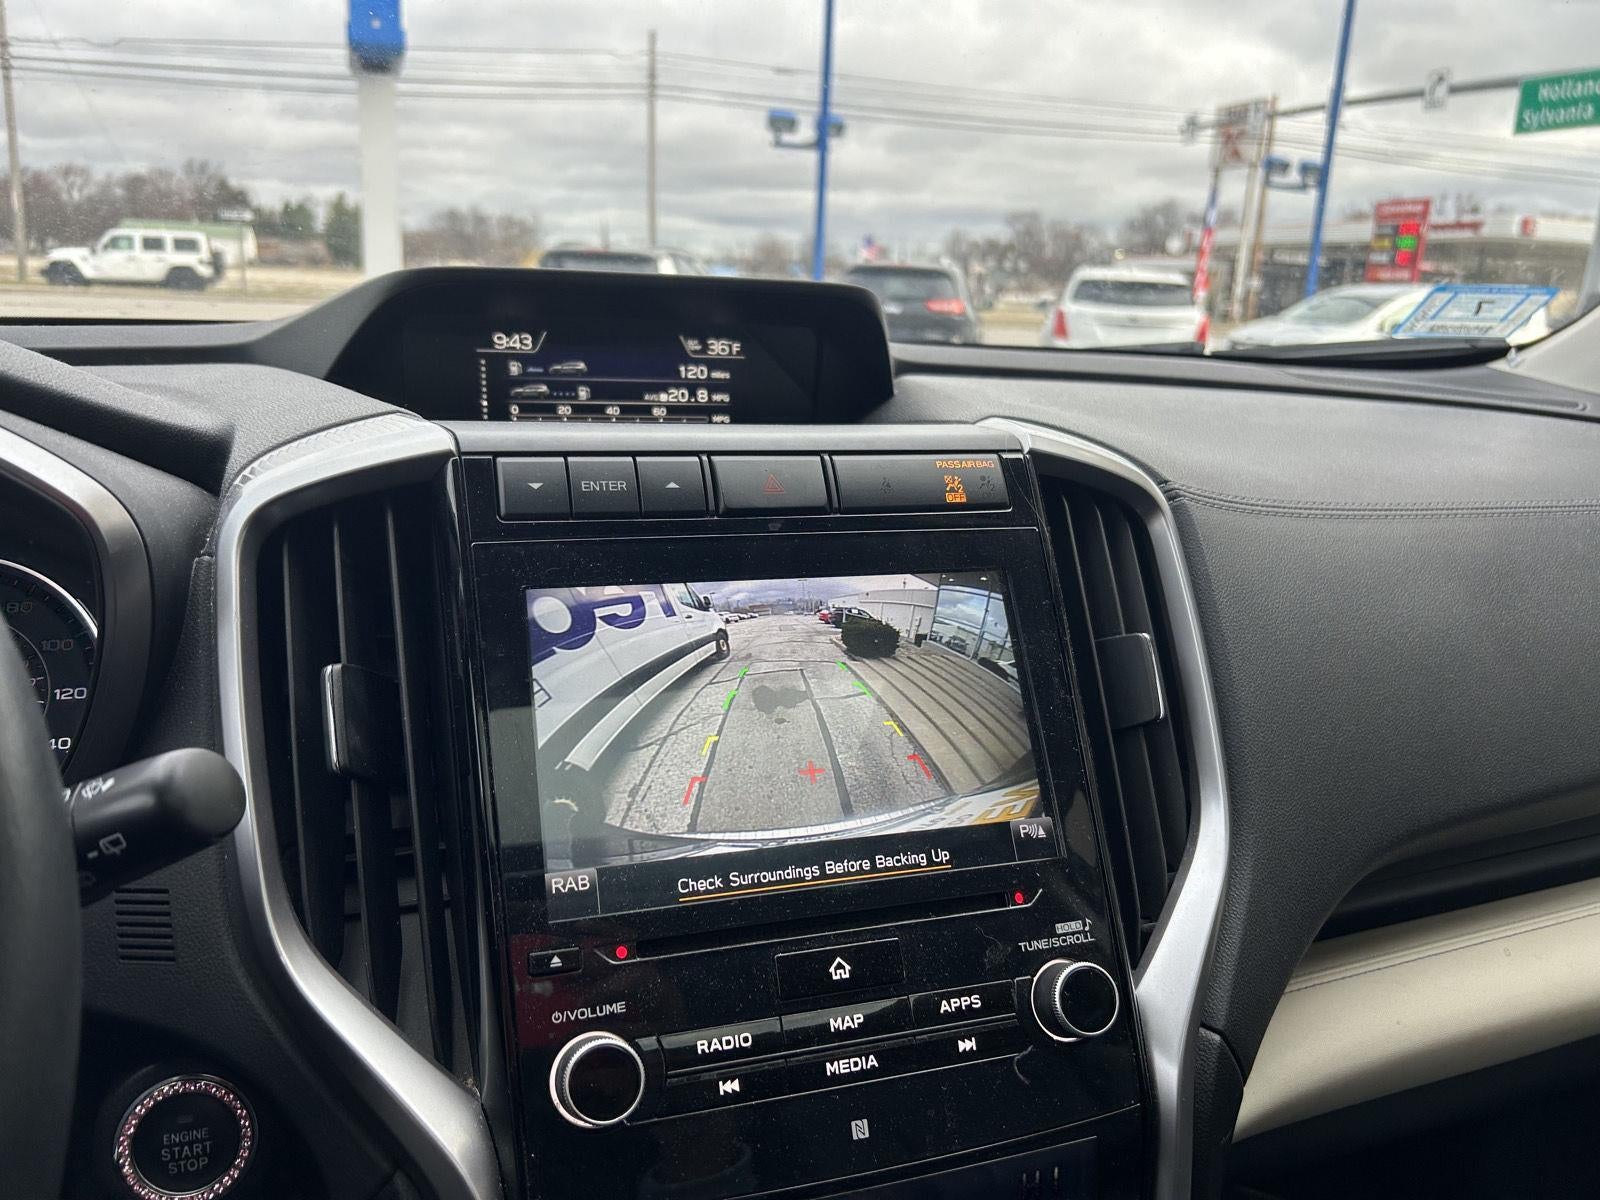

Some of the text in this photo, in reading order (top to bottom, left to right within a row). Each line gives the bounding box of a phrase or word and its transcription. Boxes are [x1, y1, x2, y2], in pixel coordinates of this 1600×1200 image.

[1522, 102, 1594, 129] Sylvania
[493, 333, 533, 350] 9:43
[679, 366, 708, 379] 120
[667, 388, 709, 402] 20.8
[510, 405, 667, 416] 0 20 40 60
[581, 480, 628, 492] ENTER
[946, 493, 966, 502] OFF
[41, 639, 74, 651] 100
[53, 687, 88, 700] 120
[677, 848, 950, 895] Check Surroundings Before Backing Up
[551, 873, 590, 894] RAB
[1055, 920, 1083, 933] HOLD
[1018, 932, 1096, 952] TUNE/SCROLL
[940, 994, 982, 1014] APPS
[829, 1012, 864, 1031] MAP
[696, 1031, 753, 1055] RADIO
[825, 1053, 879, 1077] MEDIA
[162, 1126, 210, 1145] ENGINE
[161, 1140, 213, 1161] START
[167, 1156, 209, 1174] STOP
